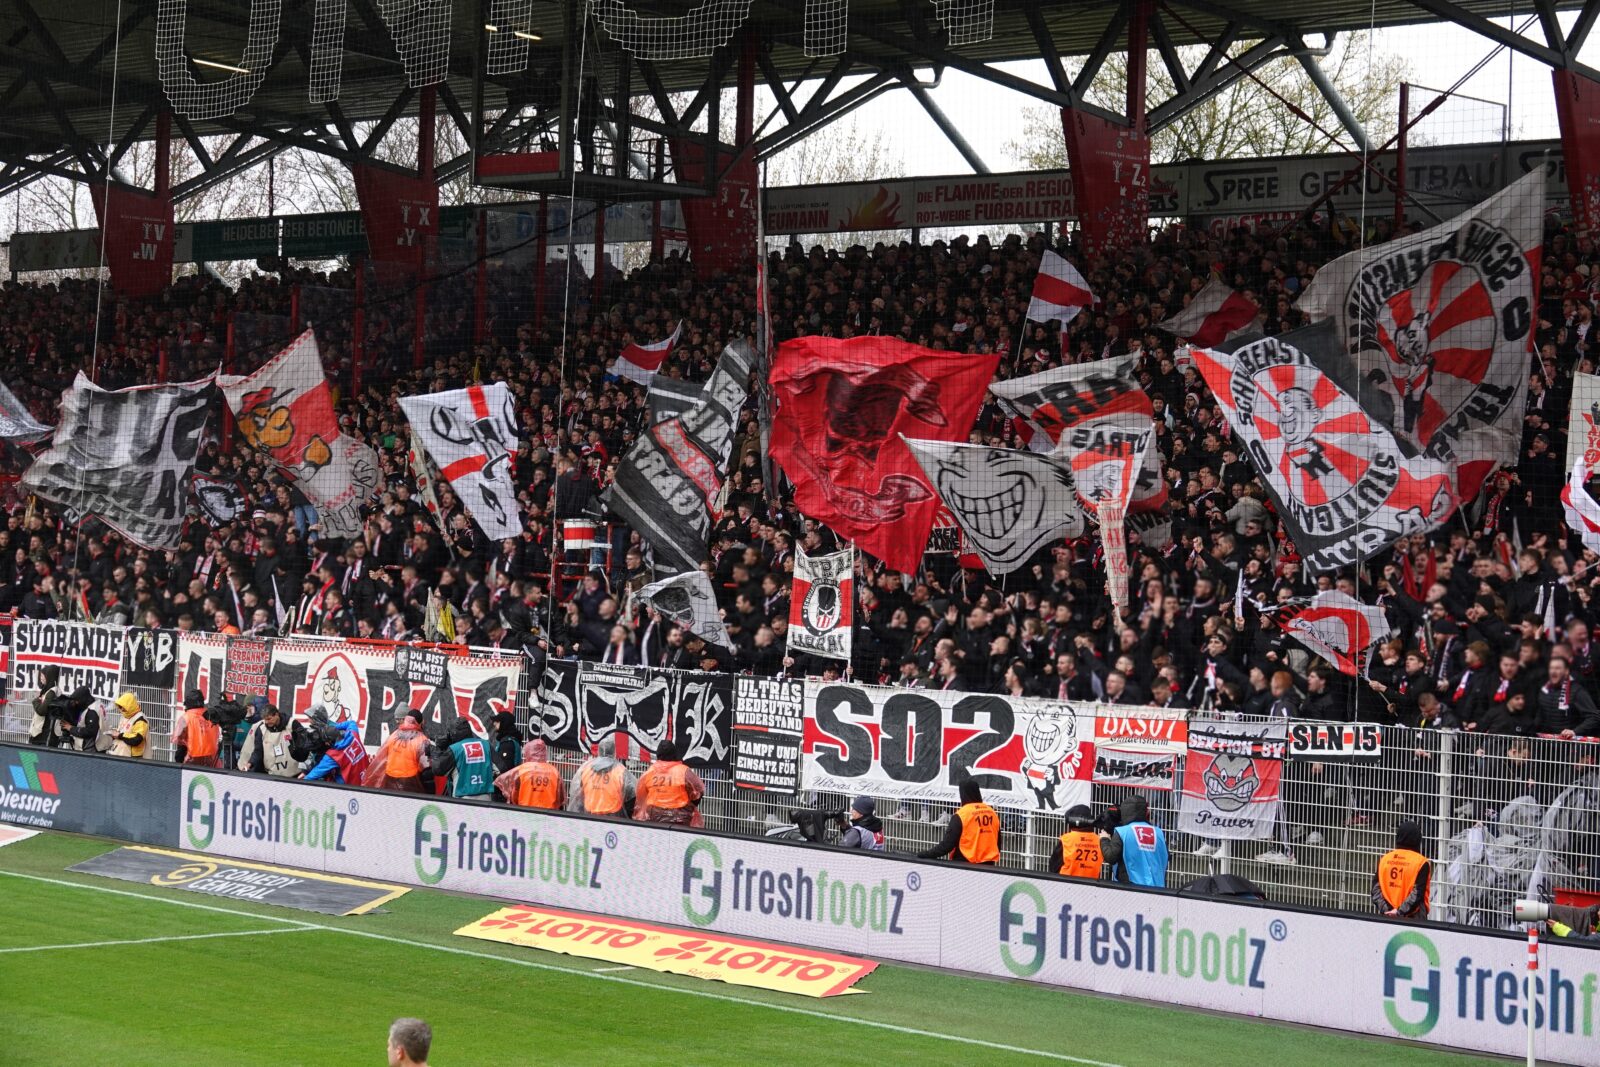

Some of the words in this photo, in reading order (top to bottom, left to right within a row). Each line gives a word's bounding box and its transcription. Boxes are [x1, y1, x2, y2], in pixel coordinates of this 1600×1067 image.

[1204, 168, 1280, 206] SPREE
[1301, 160, 1498, 198] GERÜSTBAU
[917, 190, 934, 204] DIE
[935, 182, 1000, 201] FLAMME
[1002, 187, 1023, 199] DER
[16, 623, 121, 660] SÜDBANDE
[231, 639, 266, 651] JEDER
[409, 649, 423, 661] DU
[425, 652, 446, 665] BIST
[408, 660, 444, 676] IMMER
[15, 664, 119, 699] STTGART
[407, 671, 422, 681] BEI
[424, 673, 443, 685] UNS!
[623, 677, 644, 689] ULTRAS
[184, 650, 510, 747] UTRAS
[737, 678, 802, 702] ULTRAS
[736, 698, 801, 718] BEDEUTET
[735, 711, 802, 731] WIDERSTAND
[1188, 733, 1254, 756] SEKTION
[1293, 724, 1345, 751] SLN
[1354, 726, 1378, 751] 15
[739, 740, 771, 757] KAMPF
[773, 745, 798, 760] UND
[274, 761, 289, 773] TV
[737, 756, 778, 773] EINSATZ
[470, 774, 484, 785] 21
[529, 775, 550, 787] 169
[652, 775, 673, 787] 221
[736, 770, 765, 784] UNSERE
[812, 775, 851, 791] Ultras
[854, 779, 957, 799] Schwabensturm
[0, 811, 17, 822] Welt
[16, 813, 29, 823] der
[28, 815, 54, 828] Farben
[974, 814, 994, 827] 101
[1194, 810, 1255, 829] Power
[1075, 848, 1099, 862] 273
[213, 867, 306, 888] COMEDY
[1390, 866, 1404, 881] 61
[186, 878, 278, 900] CENTRAL
